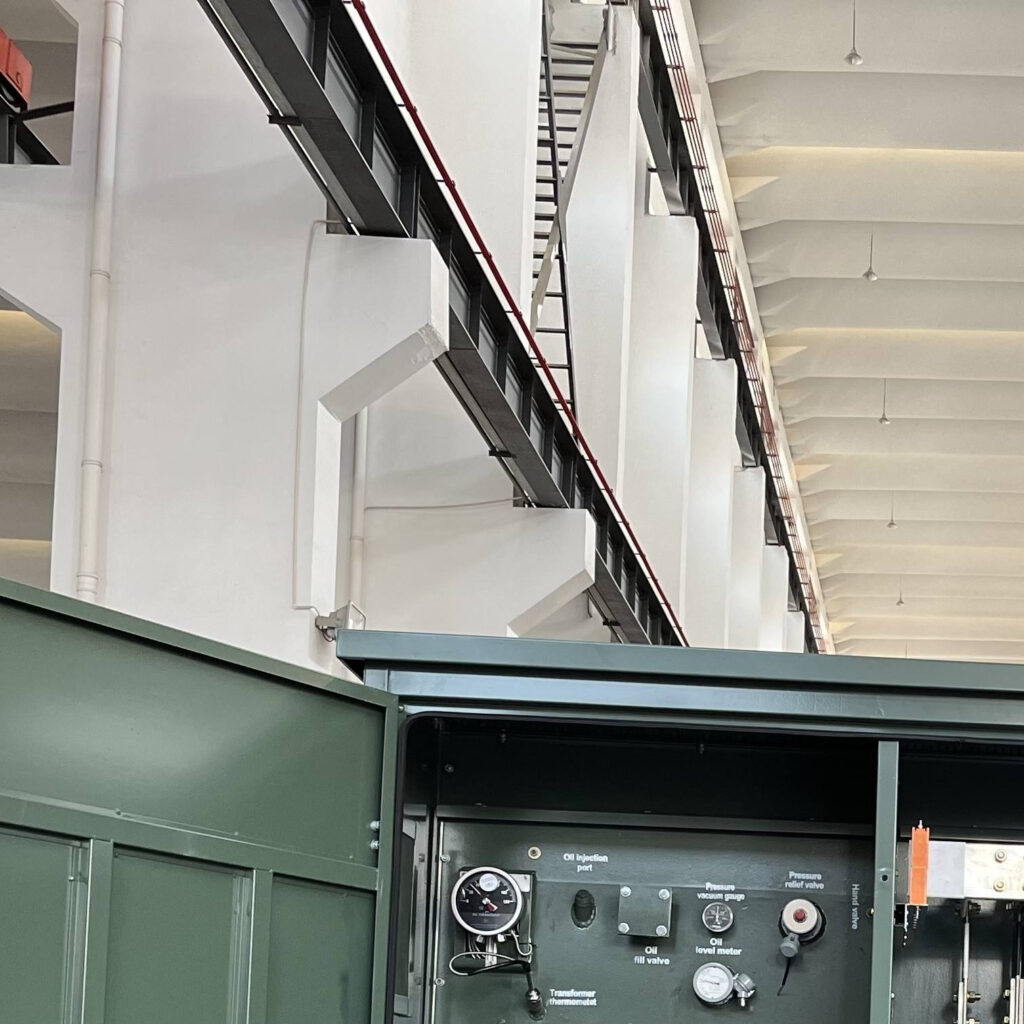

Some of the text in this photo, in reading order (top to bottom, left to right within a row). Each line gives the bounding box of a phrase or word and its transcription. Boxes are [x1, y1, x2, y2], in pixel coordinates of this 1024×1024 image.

[563, 853, 609, 863] Oil injection
[577, 864, 592, 872] port
[788, 871, 822, 880] Pressure
[785, 881, 825, 890] relief valve
[724, 893, 745, 902] gauge
[851, 883, 860, 930] Hand valve
[709, 938, 723, 946] Oil
[644, 946, 658, 955] Oil
[695, 946, 742, 955] level meter
[634, 955, 670, 965] fill valve
[549, 989, 596, 998] Transformer
